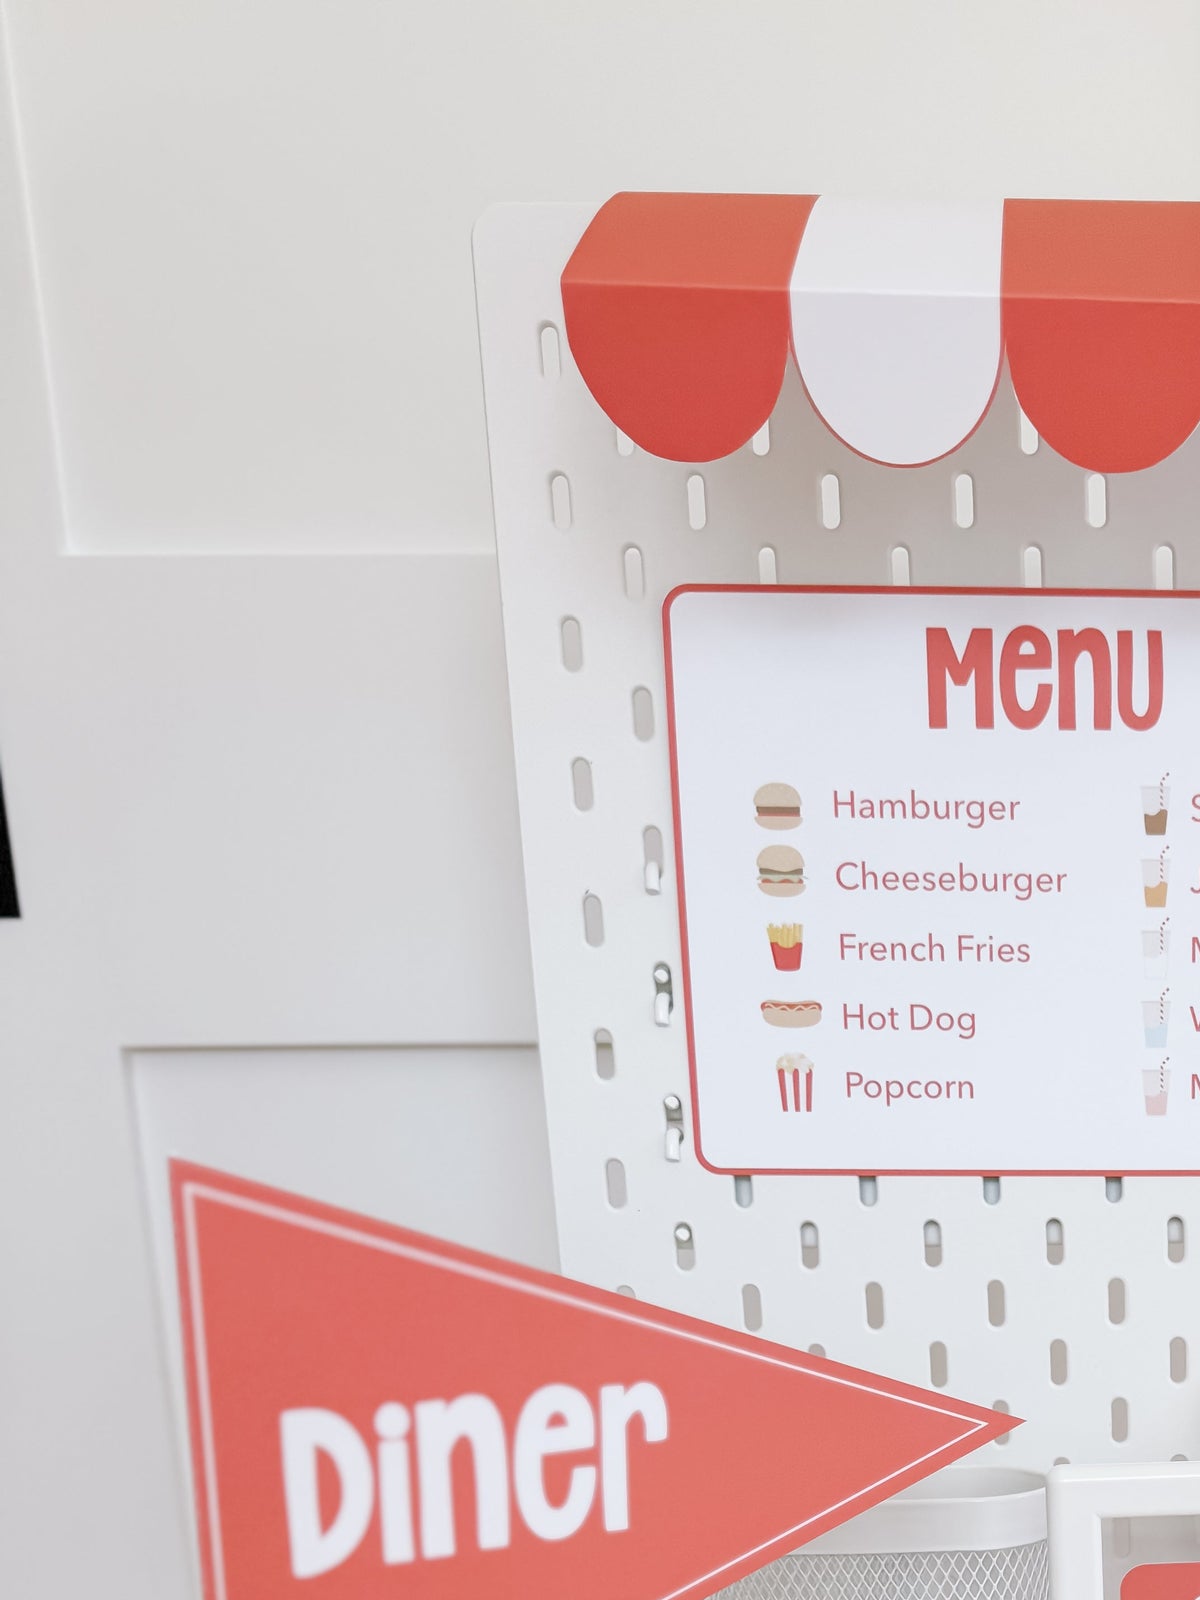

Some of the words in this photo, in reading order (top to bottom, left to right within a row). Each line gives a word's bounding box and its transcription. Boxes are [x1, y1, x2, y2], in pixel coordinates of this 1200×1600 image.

[832, 789, 1019, 830] Hamburger
[834, 860, 1067, 902] Cheeseburger
[839, 932, 945, 962] French
[956, 934, 1031, 963] Fries
[842, 1003, 897, 1031] Hot
[908, 1003, 977, 1040] Dog
[845, 1071, 975, 1106] Popcorn
